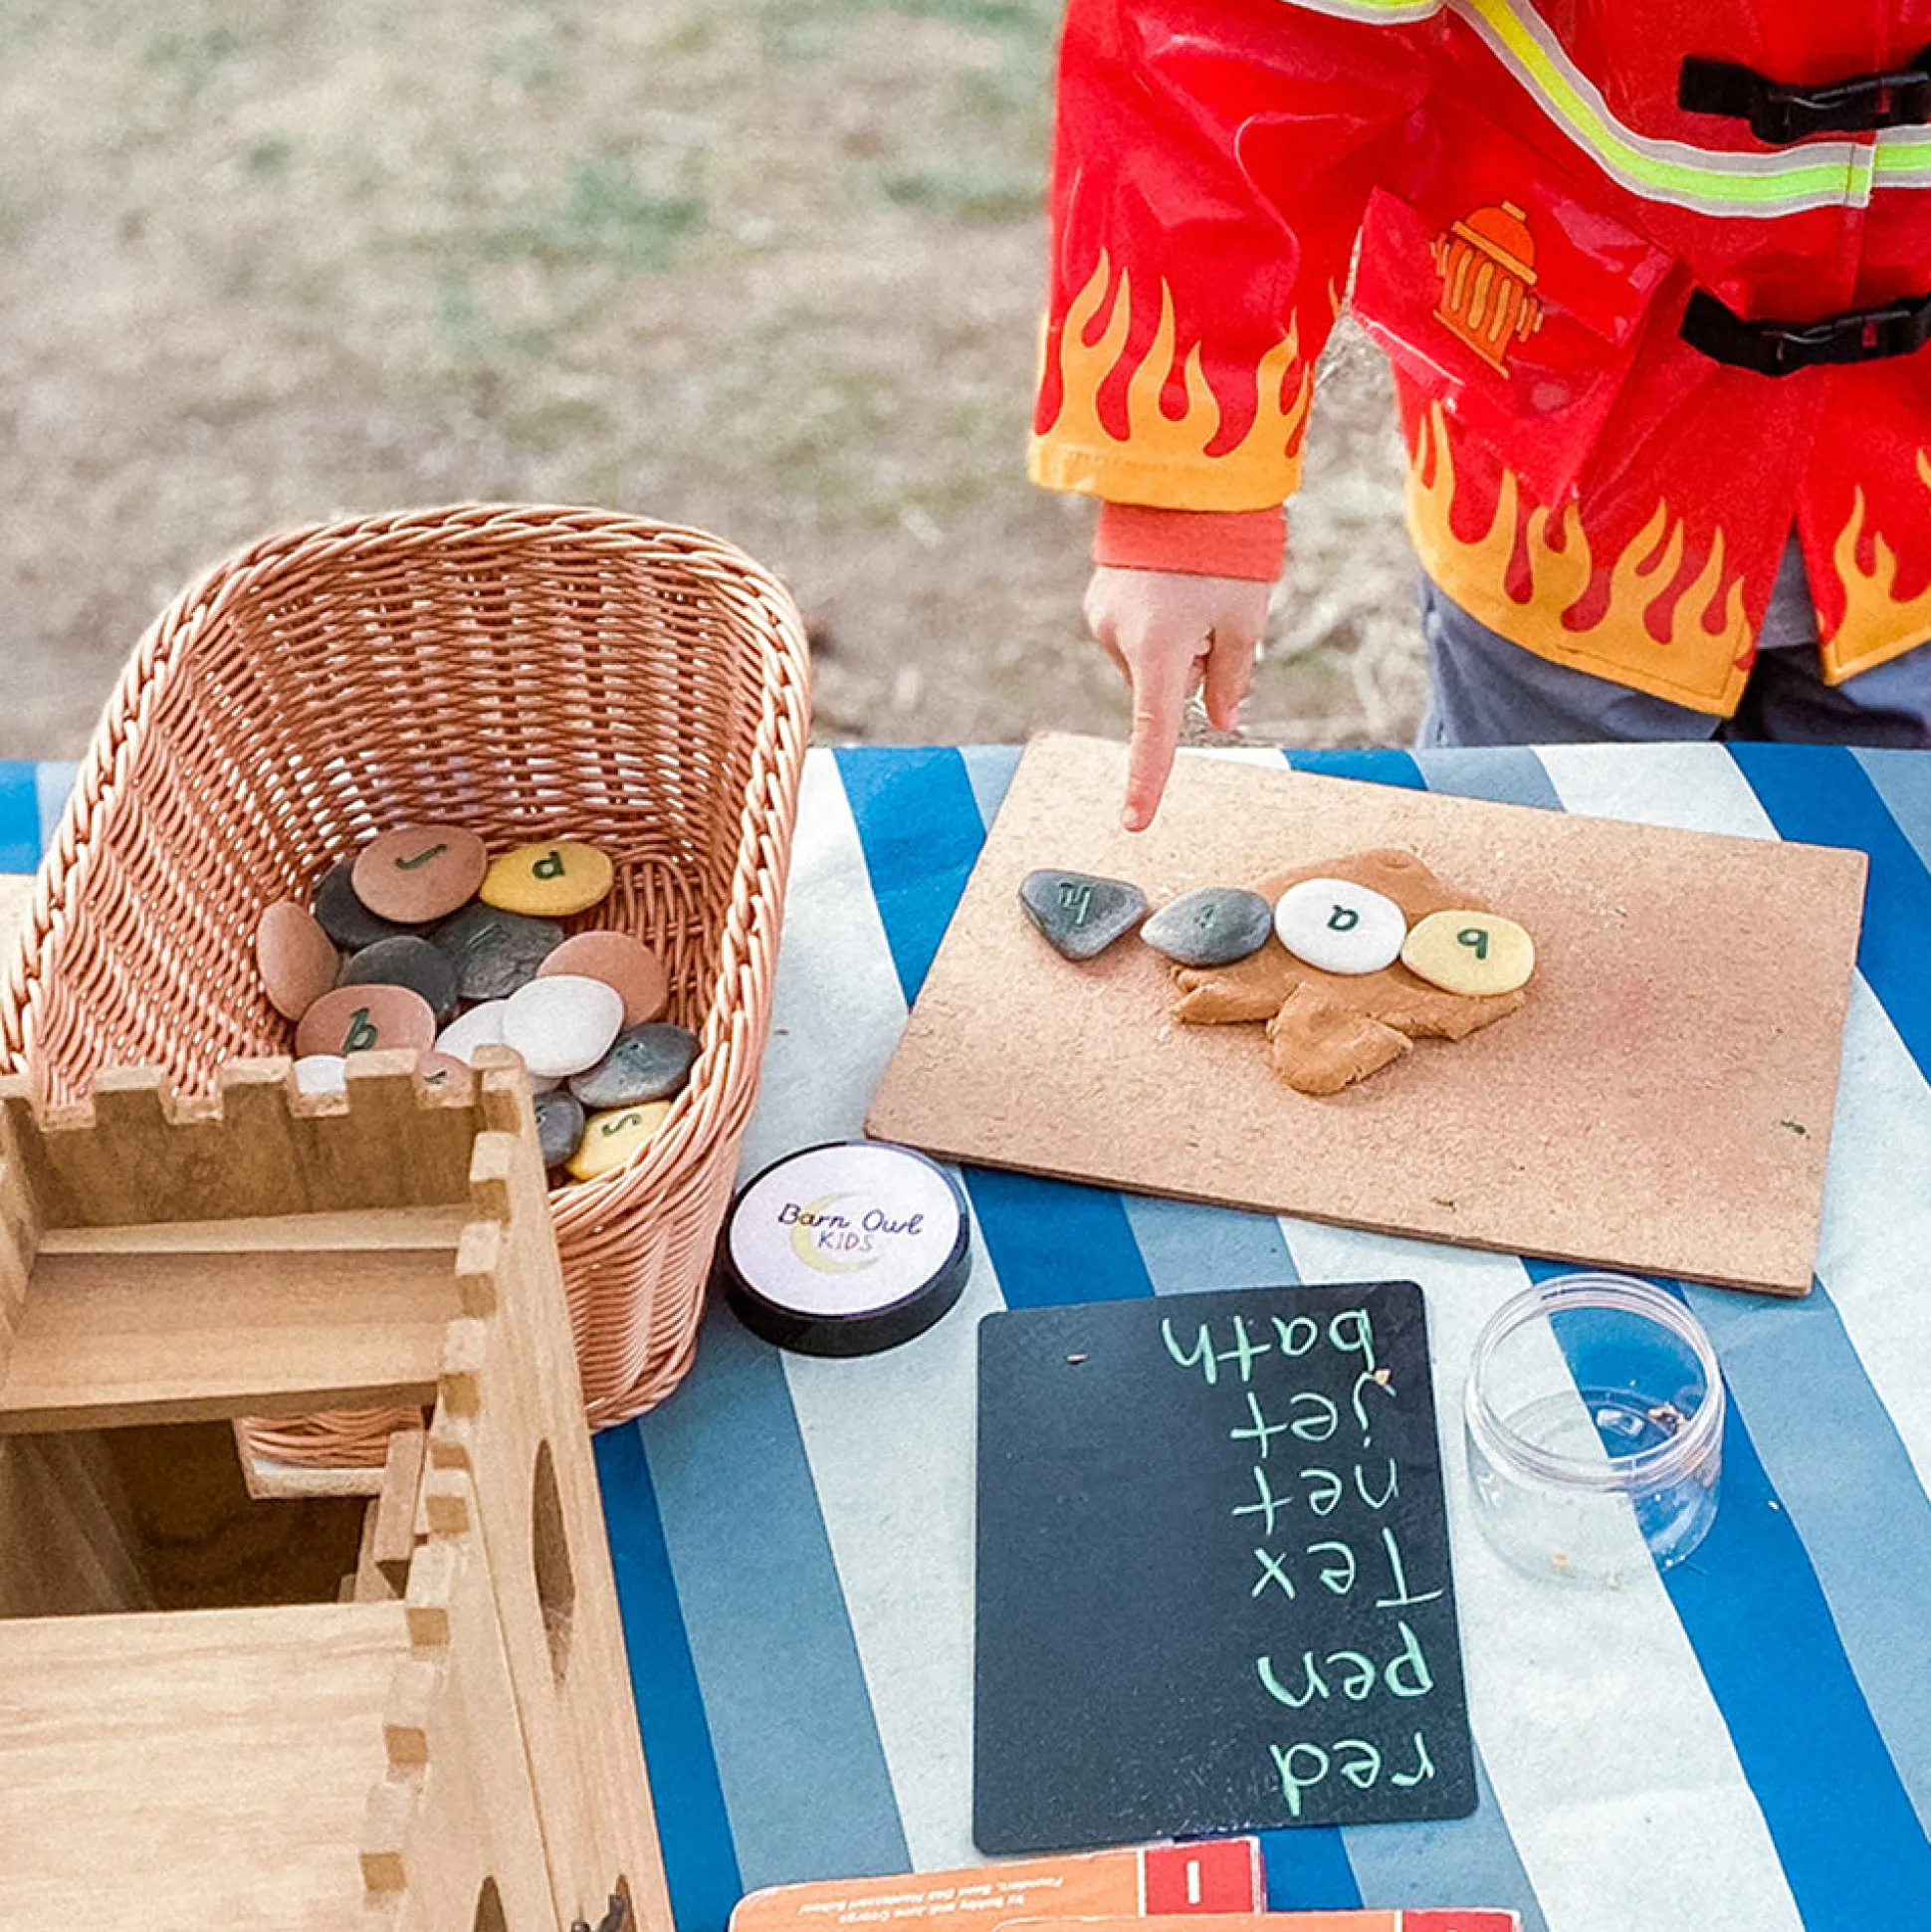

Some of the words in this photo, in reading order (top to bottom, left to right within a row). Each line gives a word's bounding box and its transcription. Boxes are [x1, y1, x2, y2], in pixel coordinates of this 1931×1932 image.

[1327, 904, 1360, 933] a
[1456, 928, 1490, 961] b
[778, 1203, 850, 1228] Barn
[862, 1208, 925, 1234] Owl
[818, 1231, 873, 1250] KIDS
[1159, 1307, 1377, 1384] bath
[1230, 1374, 1395, 1458] jet
[1232, 1458, 1399, 1535] net
[1251, 1527, 1442, 1608] Tex
[1257, 1621, 1433, 1710] pen
[1270, 1730, 1436, 1817] red
